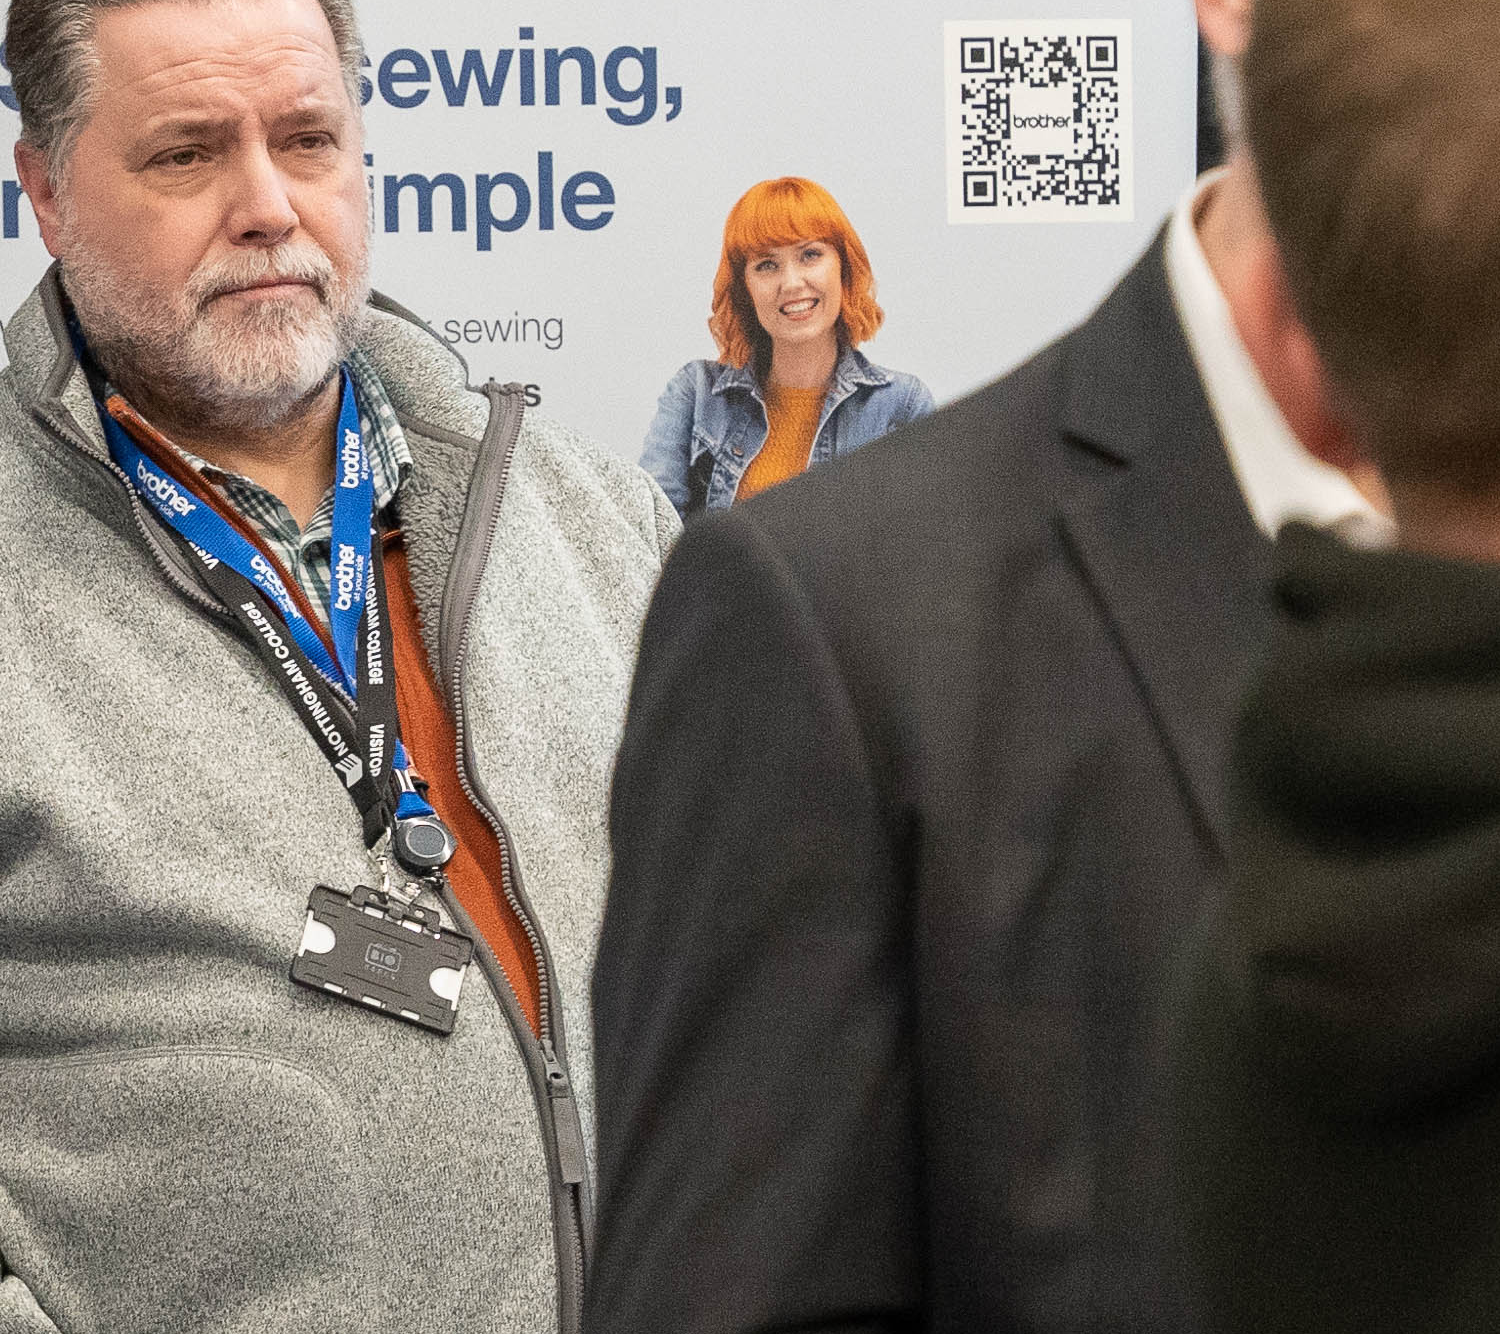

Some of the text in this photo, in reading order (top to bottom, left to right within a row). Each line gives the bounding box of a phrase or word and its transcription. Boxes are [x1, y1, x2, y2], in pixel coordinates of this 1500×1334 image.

[360, 26, 683, 127] ewing,
[1013, 114, 1071, 129] brother
[445, 311, 563, 350] sewing
[136, 459, 197, 517] brother
[340, 428, 360, 489] brother
[335, 543, 356, 611] brother
[240, 601, 349, 757] NOTTINGHAM COLLEGE
[366, 631, 384, 685] COLLEGE
